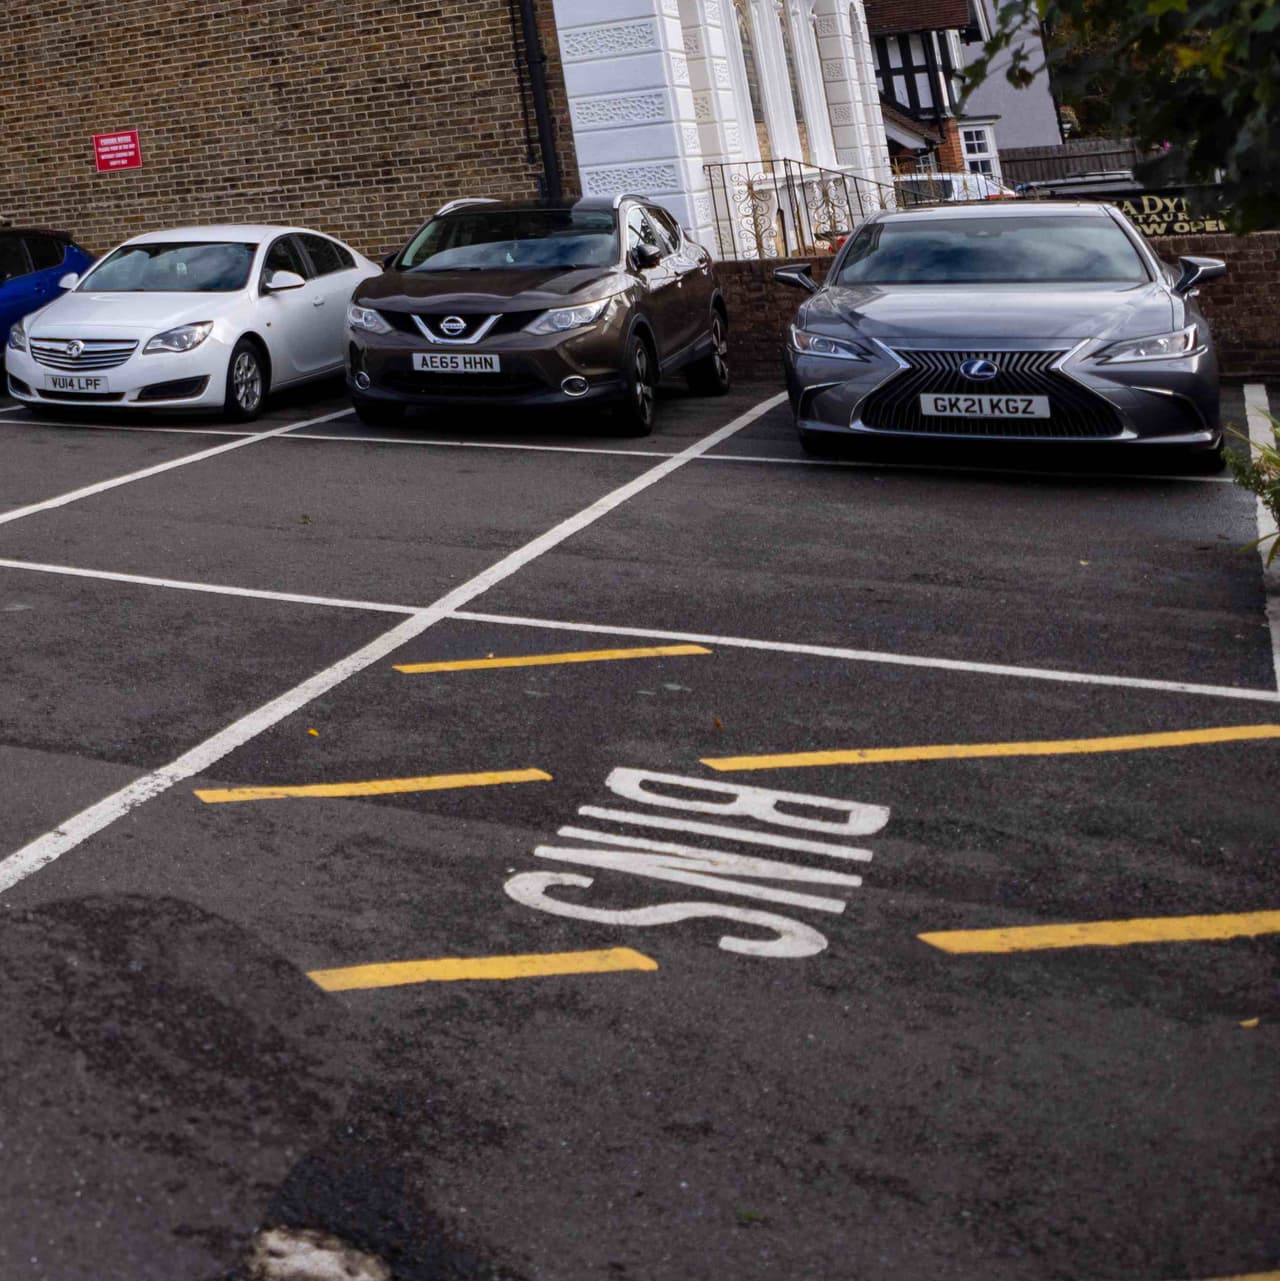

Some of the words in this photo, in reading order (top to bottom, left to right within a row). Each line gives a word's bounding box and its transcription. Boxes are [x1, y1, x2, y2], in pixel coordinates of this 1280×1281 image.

[421, 356, 459, 369] AE65
[463, 356, 494, 369] HHN
[52, 377, 74, 389] VU14
[78, 378, 101, 390] LPF
[934, 397, 984, 414] GK21
[989, 398, 1035, 415] KGZ
[505, 766, 890, 959] BINS
